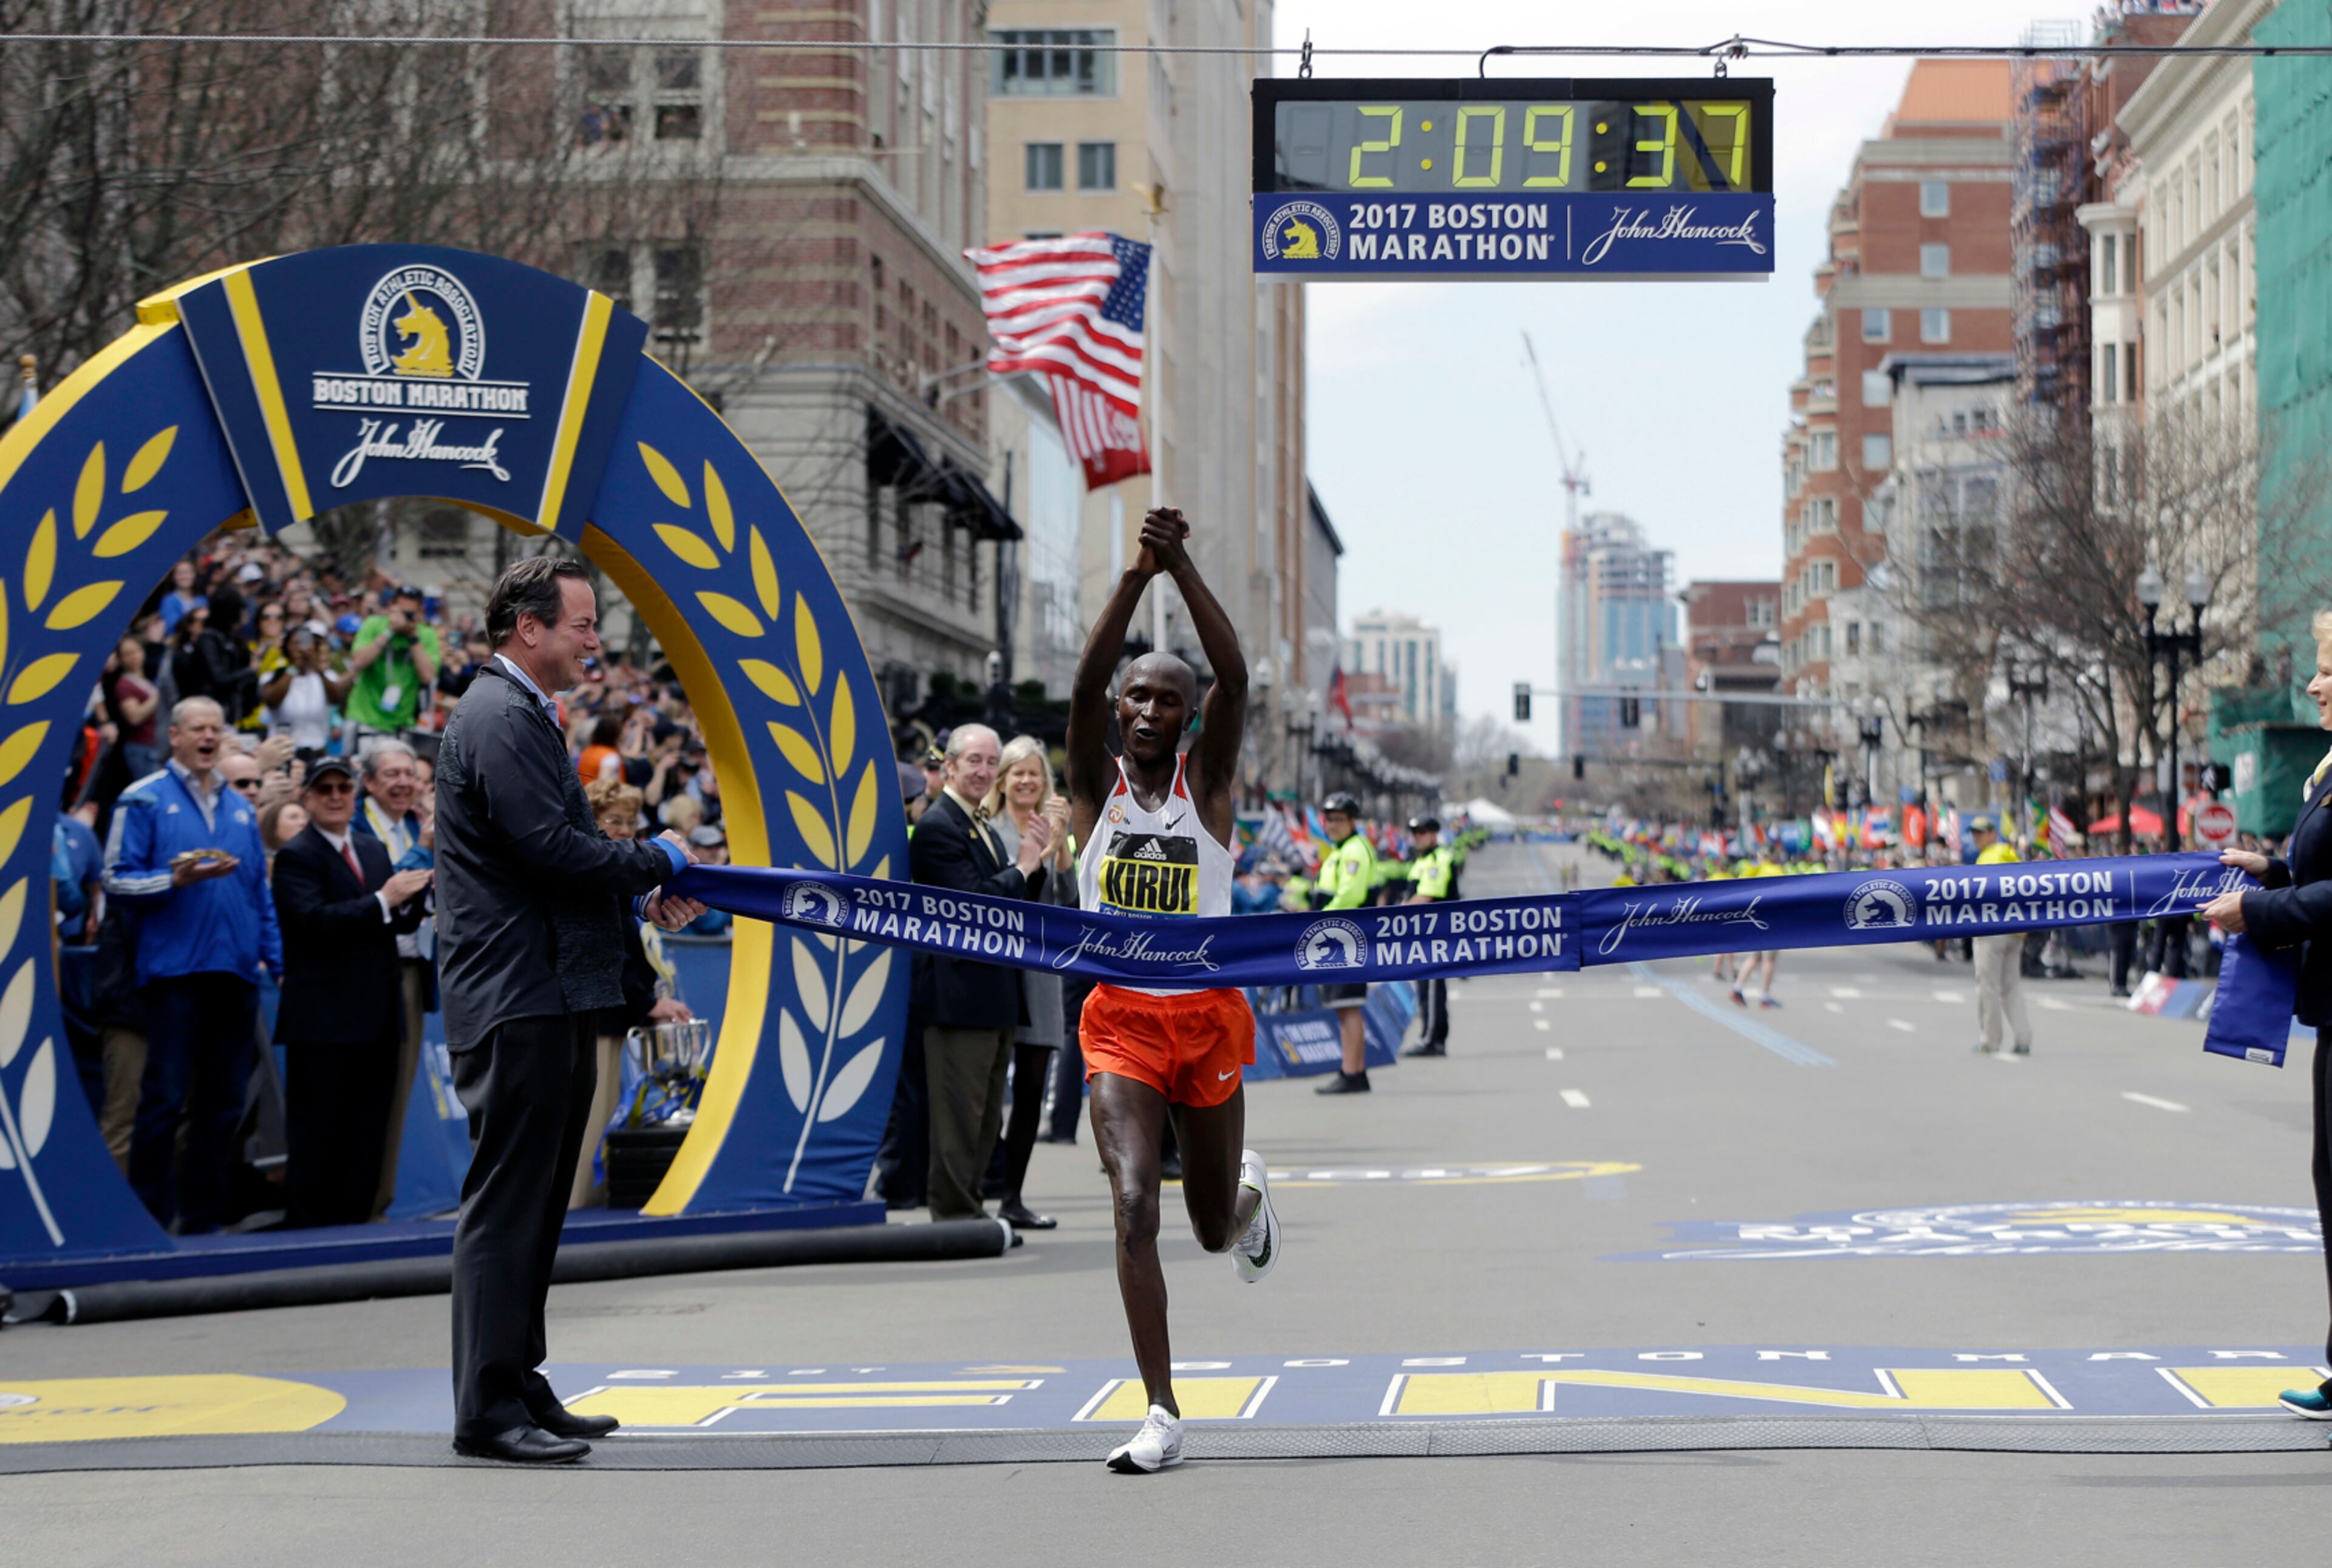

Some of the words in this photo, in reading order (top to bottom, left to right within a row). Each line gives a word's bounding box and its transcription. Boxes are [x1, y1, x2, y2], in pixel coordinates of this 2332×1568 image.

[1348, 105, 1748, 188] 2:09:37
[1265, 223, 1277, 254] BOSTON
[1273, 204, 1311, 223] ATHLETIC
[1310, 206, 1338, 254] ASSOCIATION
[1349, 203, 1416, 229] 2017
[1428, 203, 1547, 229] BOSTON
[1581, 206, 1657, 265] John
[1654, 204, 1767, 255] Hancock
[366, 302, 383, 366] BOSTON
[375, 271, 435, 305] ATHLETIC
[434, 276, 479, 371] ASSOCIATION
[313, 378, 403, 406] BOSTON
[407, 382, 529, 412] MARATHON
[330, 417, 407, 488] John
[403, 418, 512, 482] Hancock
[1133, 850, 1168, 861] adidas
[853, 887, 910, 911] 2017
[922, 895, 1025, 933] BOSTON
[1106, 860, 1192, 912] KIRUI
[1925, 876, 1989, 901] 2017
[1999, 870, 2112, 897] BOSTON
[2146, 868, 2214, 918] John
[1304, 920, 1340, 939] ATHLETIC
[1376, 913, 1438, 938] 2017
[1450, 906, 1562, 933] BOSTON
[1598, 901, 1666, 955] John
[1663, 895, 1770, 930] Hancock
[1052, 924, 1121, 970] John
[1116, 931, 1221, 972] Hancock
